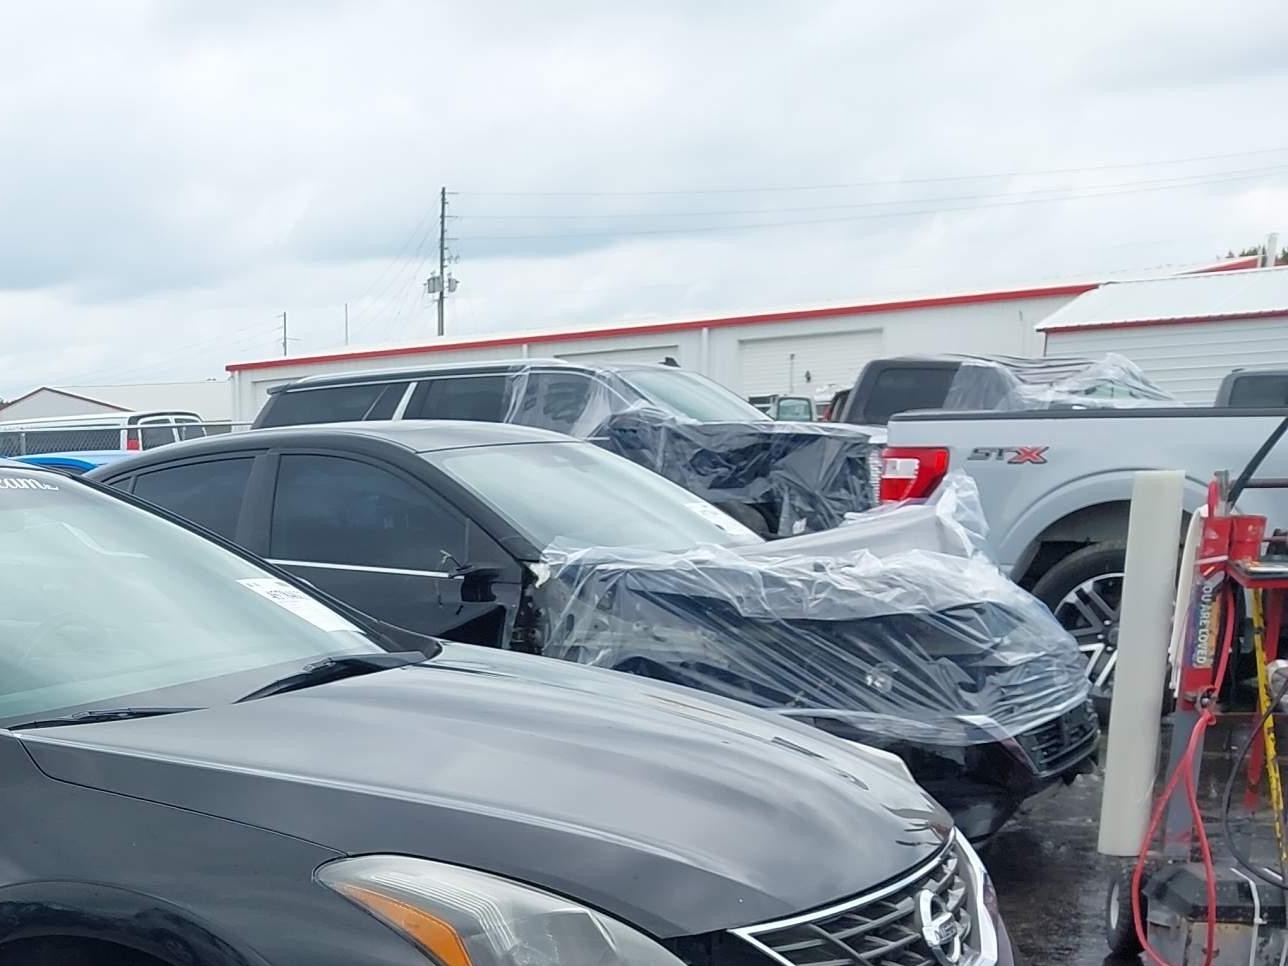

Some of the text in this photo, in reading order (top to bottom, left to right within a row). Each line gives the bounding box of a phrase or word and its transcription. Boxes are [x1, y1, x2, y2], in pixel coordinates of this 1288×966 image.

[967, 446, 1051, 465] STX
[1196, 584, 1214, 664] OU ARE LOVED
